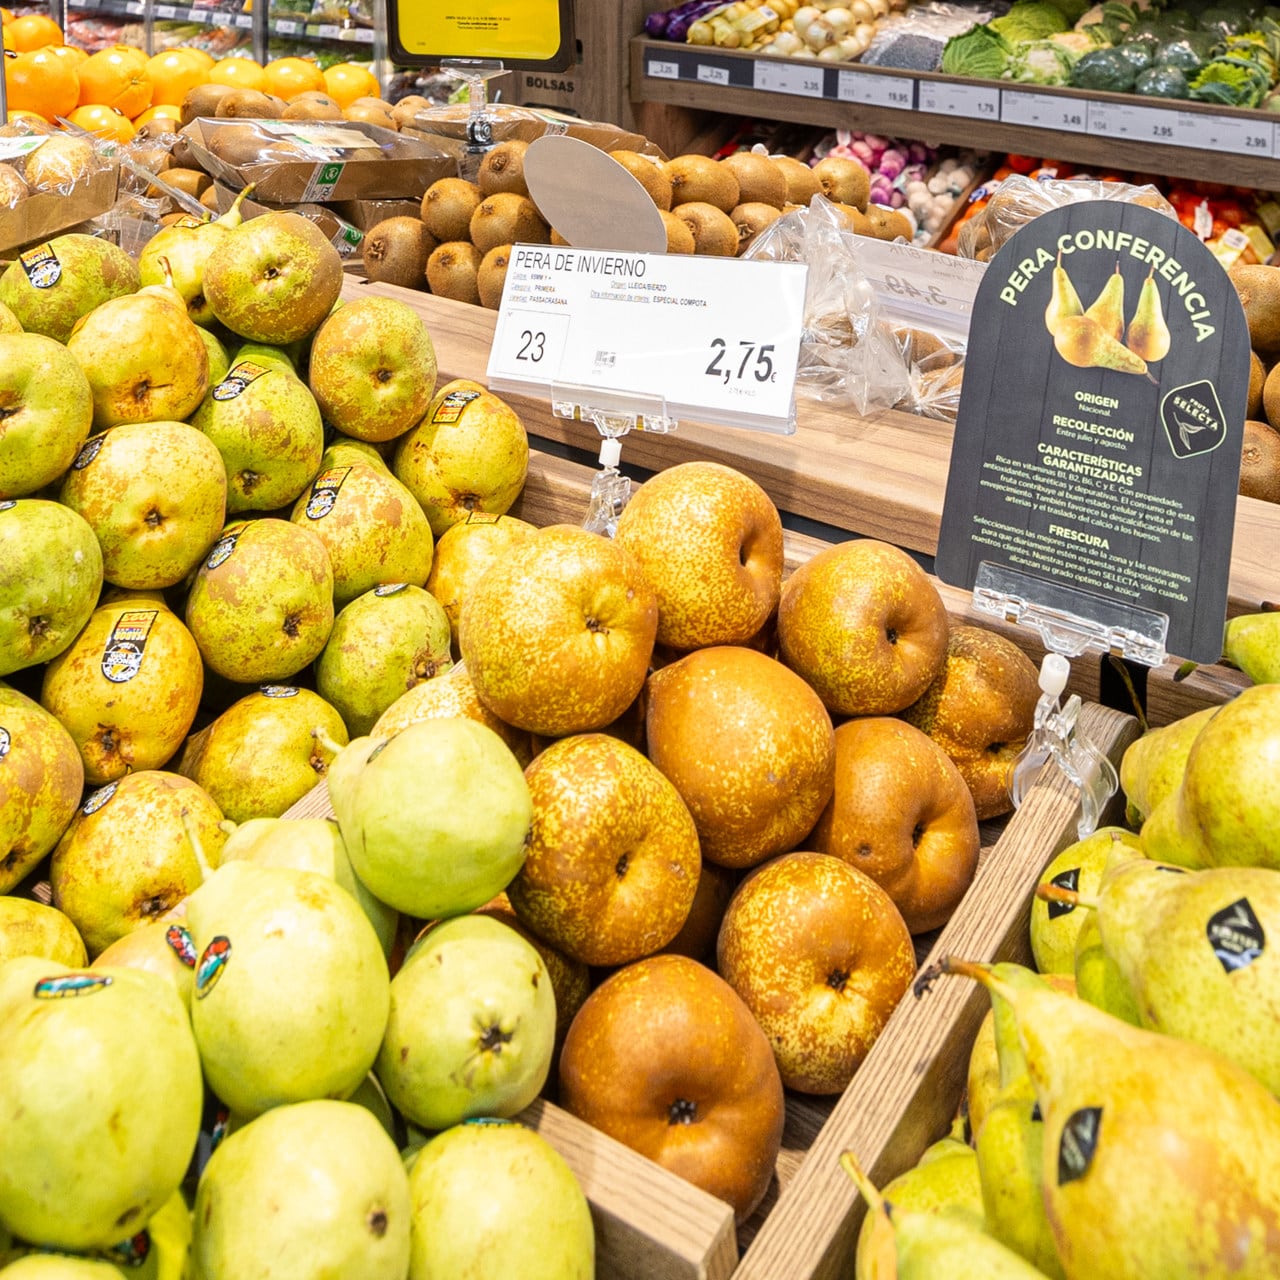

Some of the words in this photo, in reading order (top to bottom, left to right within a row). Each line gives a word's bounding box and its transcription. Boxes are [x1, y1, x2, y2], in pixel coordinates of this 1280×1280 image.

[526, 76, 575, 93] BOLSAS
[515, 251, 552, 270] PERA
[554, 254, 575, 272] DE
[577, 255, 646, 278] INVIERNO
[652, 295, 679, 305] ESPECIAL
[679, 298, 707, 307] COMPOTA
[999, 247, 1056, 306] PERA
[1057, 229, 1216, 343] CONFERENCIA
[516, 329, 547, 363] 23
[1074, 391, 1119, 409] ORIGEN
[1078, 403, 1112, 417] Nacional.
[1173, 395, 1219, 432] SELECTA
[1189, 397, 1211, 415] FRUTA
[1053, 414, 1135, 443] RECOLECCIÓN
[1056, 428, 1077, 440] Entre
[1077, 431, 1094, 444] julio
[1099, 439, 1128, 452] agosto.
[1037, 442, 1143, 477] CARACTERÍSTICAS
[1043, 456, 1134, 486] GARANTIZADAS
[995, 454, 1011, 465] Rica
[1023, 463, 1056, 476] vitaminas
[1118, 486, 1134, 497] Con
[1135, 491, 1183, 509] propiedades
[1032, 474, 1067, 489] diuréticas
[1130, 500, 1165, 514] consumo
[1166, 509, 1177, 518] de
[1177, 512, 1195, 523] esta
[1000, 474, 1017, 485] fruta
[1018, 480, 1057, 496] contribuye
[1065, 491, 1084, 503] buen
[1085, 497, 1111, 510] estado
[1112, 504, 1137, 517] celular
[1145, 513, 1165, 524] evita
[1005, 495, 1032, 508] arterias
[1047, 506, 1077, 520] traslado
[1078, 515, 1090, 523] del
[1090, 518, 1113, 530] calcio
[1120, 525, 1132, 536] los
[1133, 528, 1161, 543] huesos.
[1035, 492, 1067, 508] También
[1067, 501, 1100, 516] favorece
[1170, 529, 1181, 538] de
[1181, 532, 1194, 542] las
[973, 514, 1024, 536] Seleccionamos
[1025, 529, 1036, 539] las
[1037, 533, 1065, 548] mejores
[1066, 541, 1087, 554] peras
[1108, 554, 1127, 565] zona
[1135, 560, 1146, 570] las
[1147, 565, 1191, 583] envasamos
[1048, 524, 1110, 550] FRESCURA
[971, 534, 1001, 548] nuestros
[1002, 543, 1030, 556] clientes.
[1032, 550, 1064, 567] Nuestras
[1065, 561, 1087, 573] peras
[1087, 567, 1101, 577] son
[1102, 570, 1139, 588] SELECTA
[1140, 582, 1157, 593] sólo
[1158, 588, 1188, 602] cuando
[981, 527, 998, 538] para
[998, 532, 1012, 542] que
[1013, 536, 1055, 553] diariamente
[1056, 548, 1077, 560] estén
[1078, 556, 1115, 572] expuestas
[1123, 567, 1167, 586] disposición
[1168, 580, 1179, 589] de
[1009, 554, 1040, 569] alcanzan
[1051, 567, 1074, 579] grado
